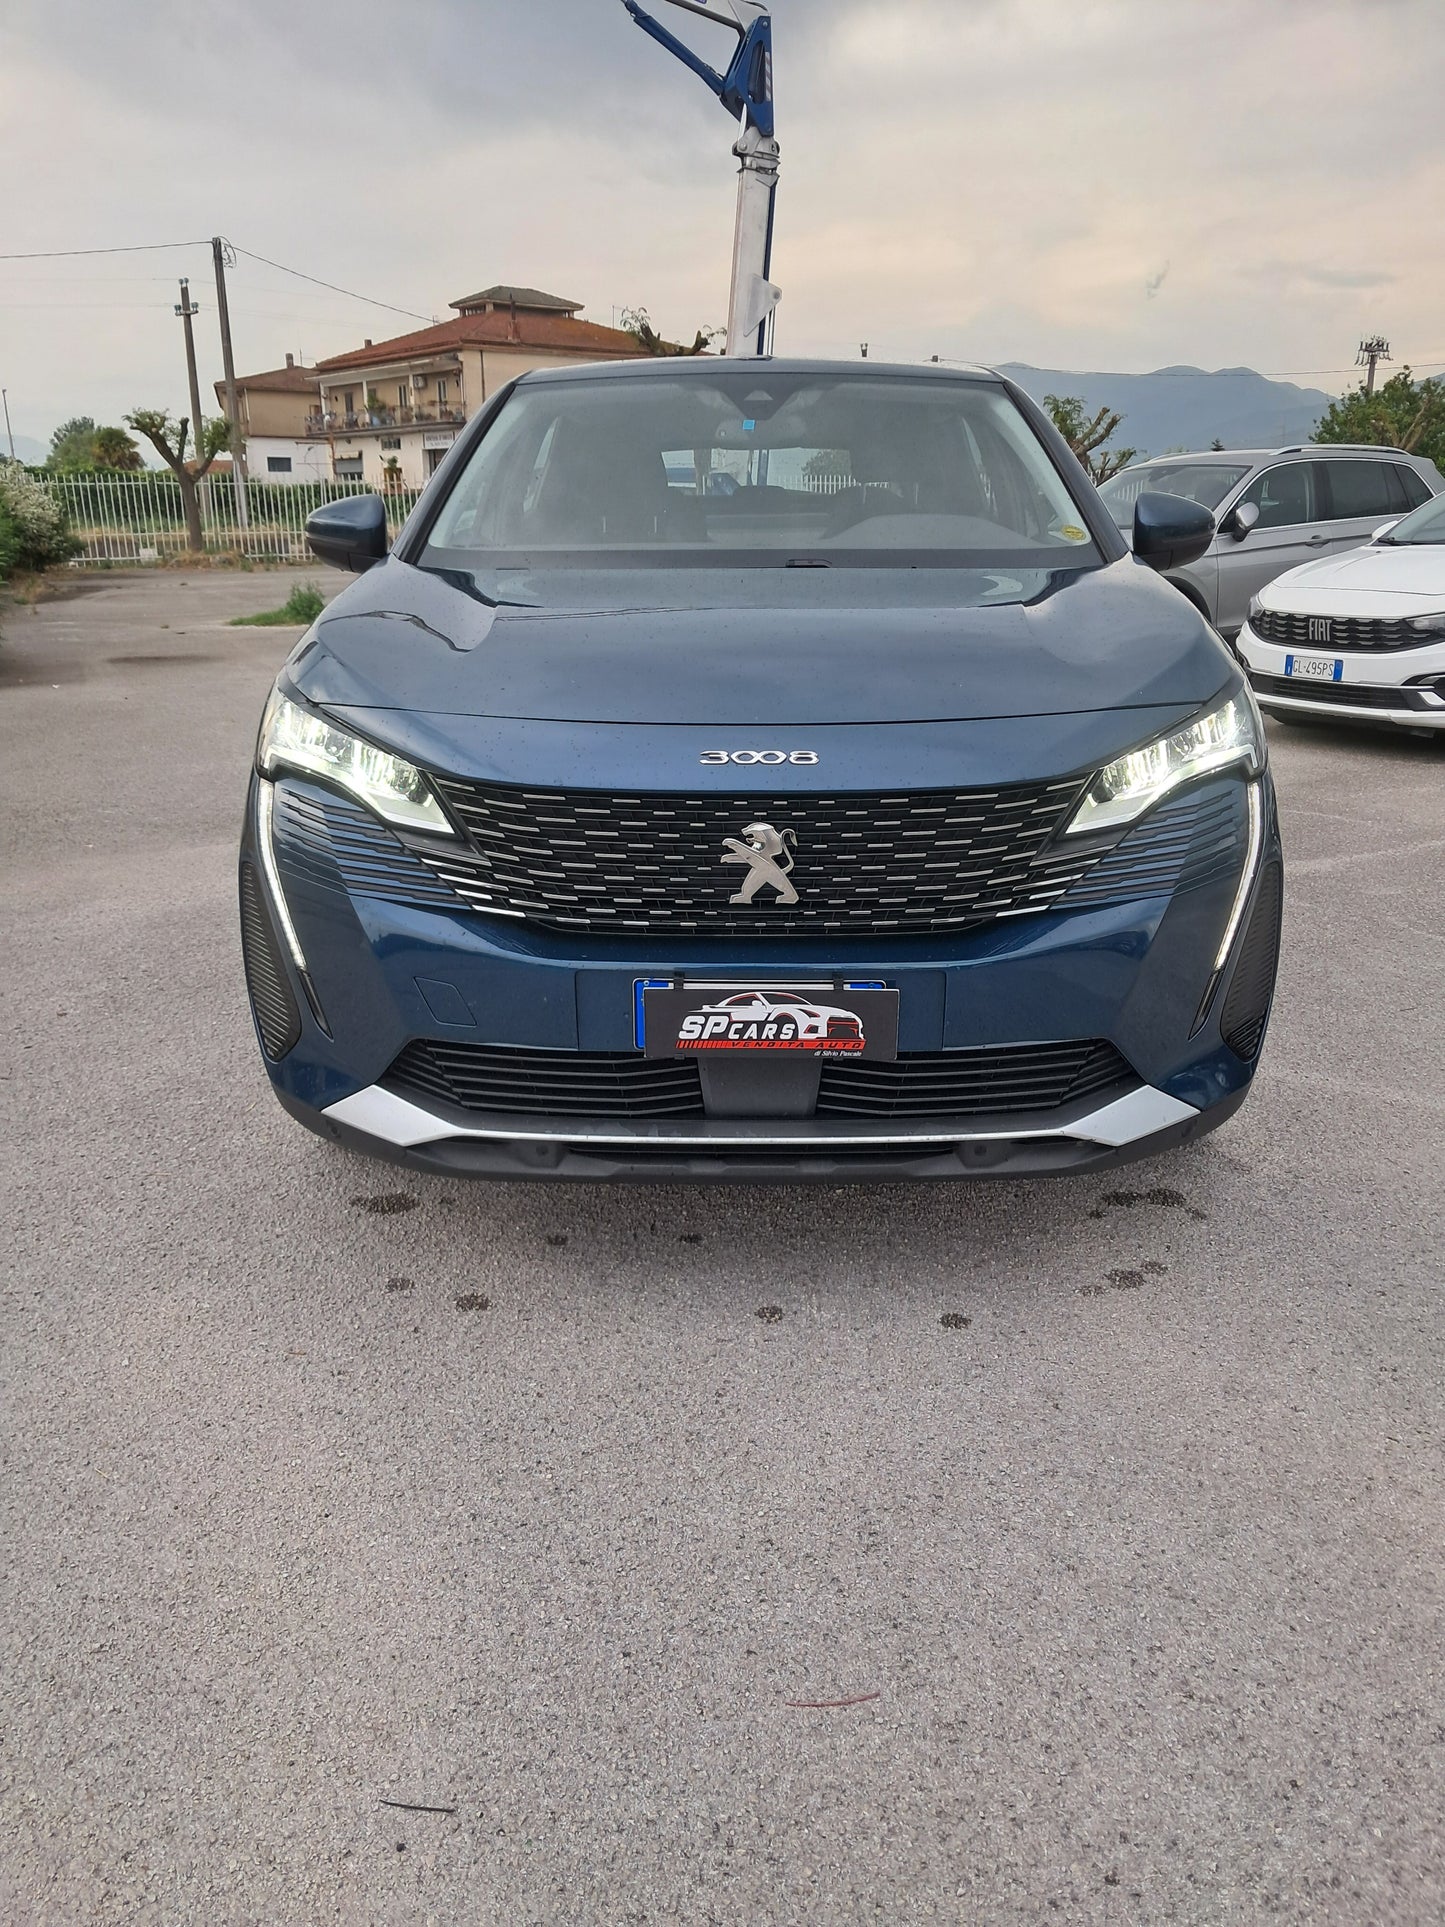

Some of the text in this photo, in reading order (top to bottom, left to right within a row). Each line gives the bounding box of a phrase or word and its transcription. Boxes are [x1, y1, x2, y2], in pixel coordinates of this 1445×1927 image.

[1309, 619, 1333, 641] FIAT
[699, 750, 820, 766] 3008
[731, 1041, 805, 1049] VENDITA
